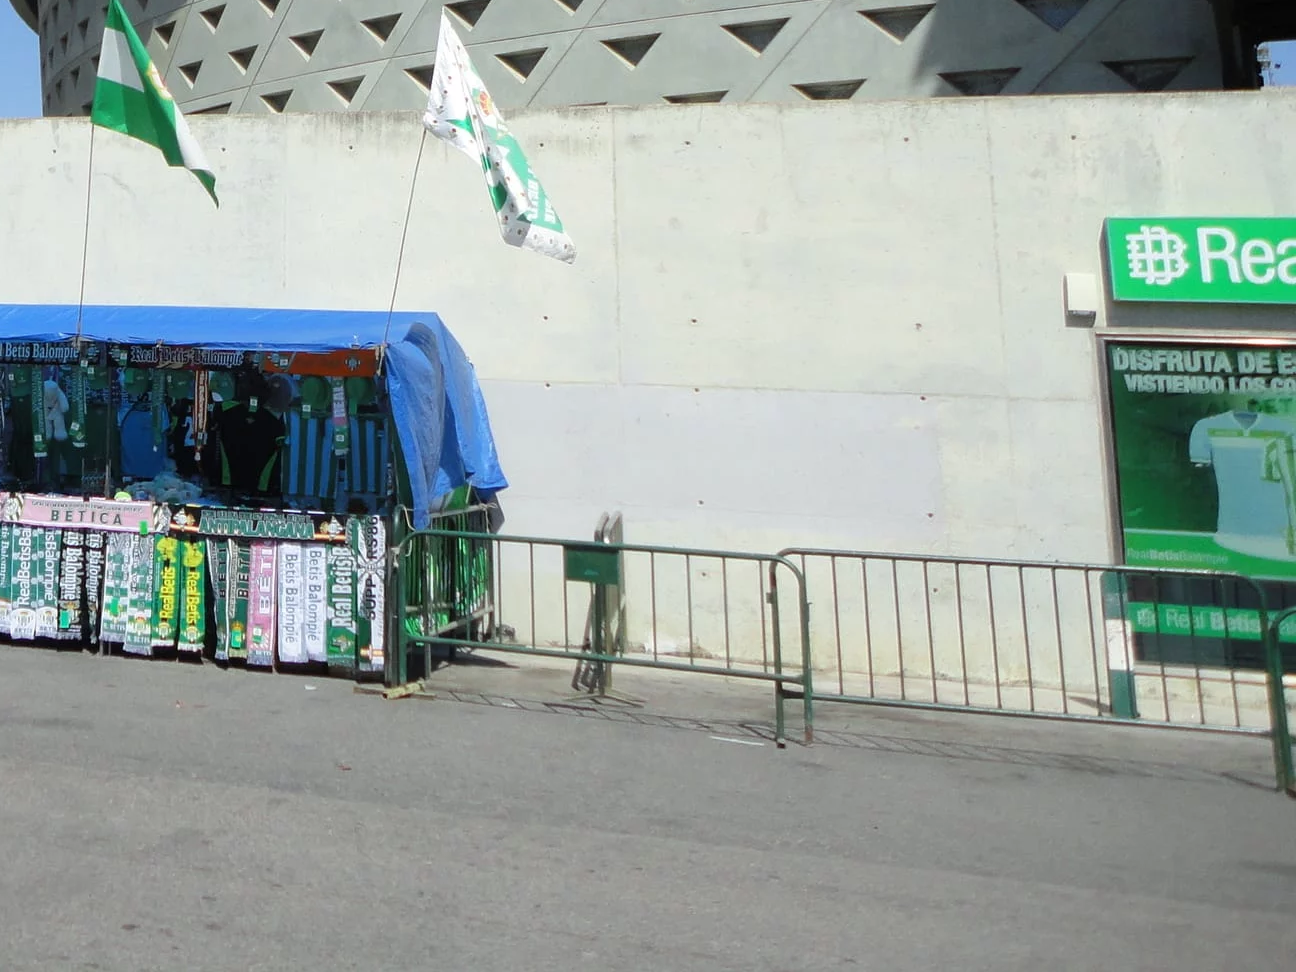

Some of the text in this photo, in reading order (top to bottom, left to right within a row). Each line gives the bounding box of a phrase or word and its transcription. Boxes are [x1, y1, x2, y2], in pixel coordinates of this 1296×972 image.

[5, 343, 31, 358] Betis
[130, 346, 159, 363] Real
[159, 346, 190, 364] Betis
[1111, 348, 1232, 374] DISFRUTA
[1237, 351, 1272, 374] DE
[1124, 374, 1225, 395] VISTIENDO
[1228, 376, 1265, 395] LOS
[51, 510, 122, 525] BETICA
[285, 553, 298, 586] Betis
[309, 550, 322, 581] Betis
[331, 560, 353, 595] Betis
[332, 598, 352, 628] Real
[1166, 609, 1204, 628] Real
